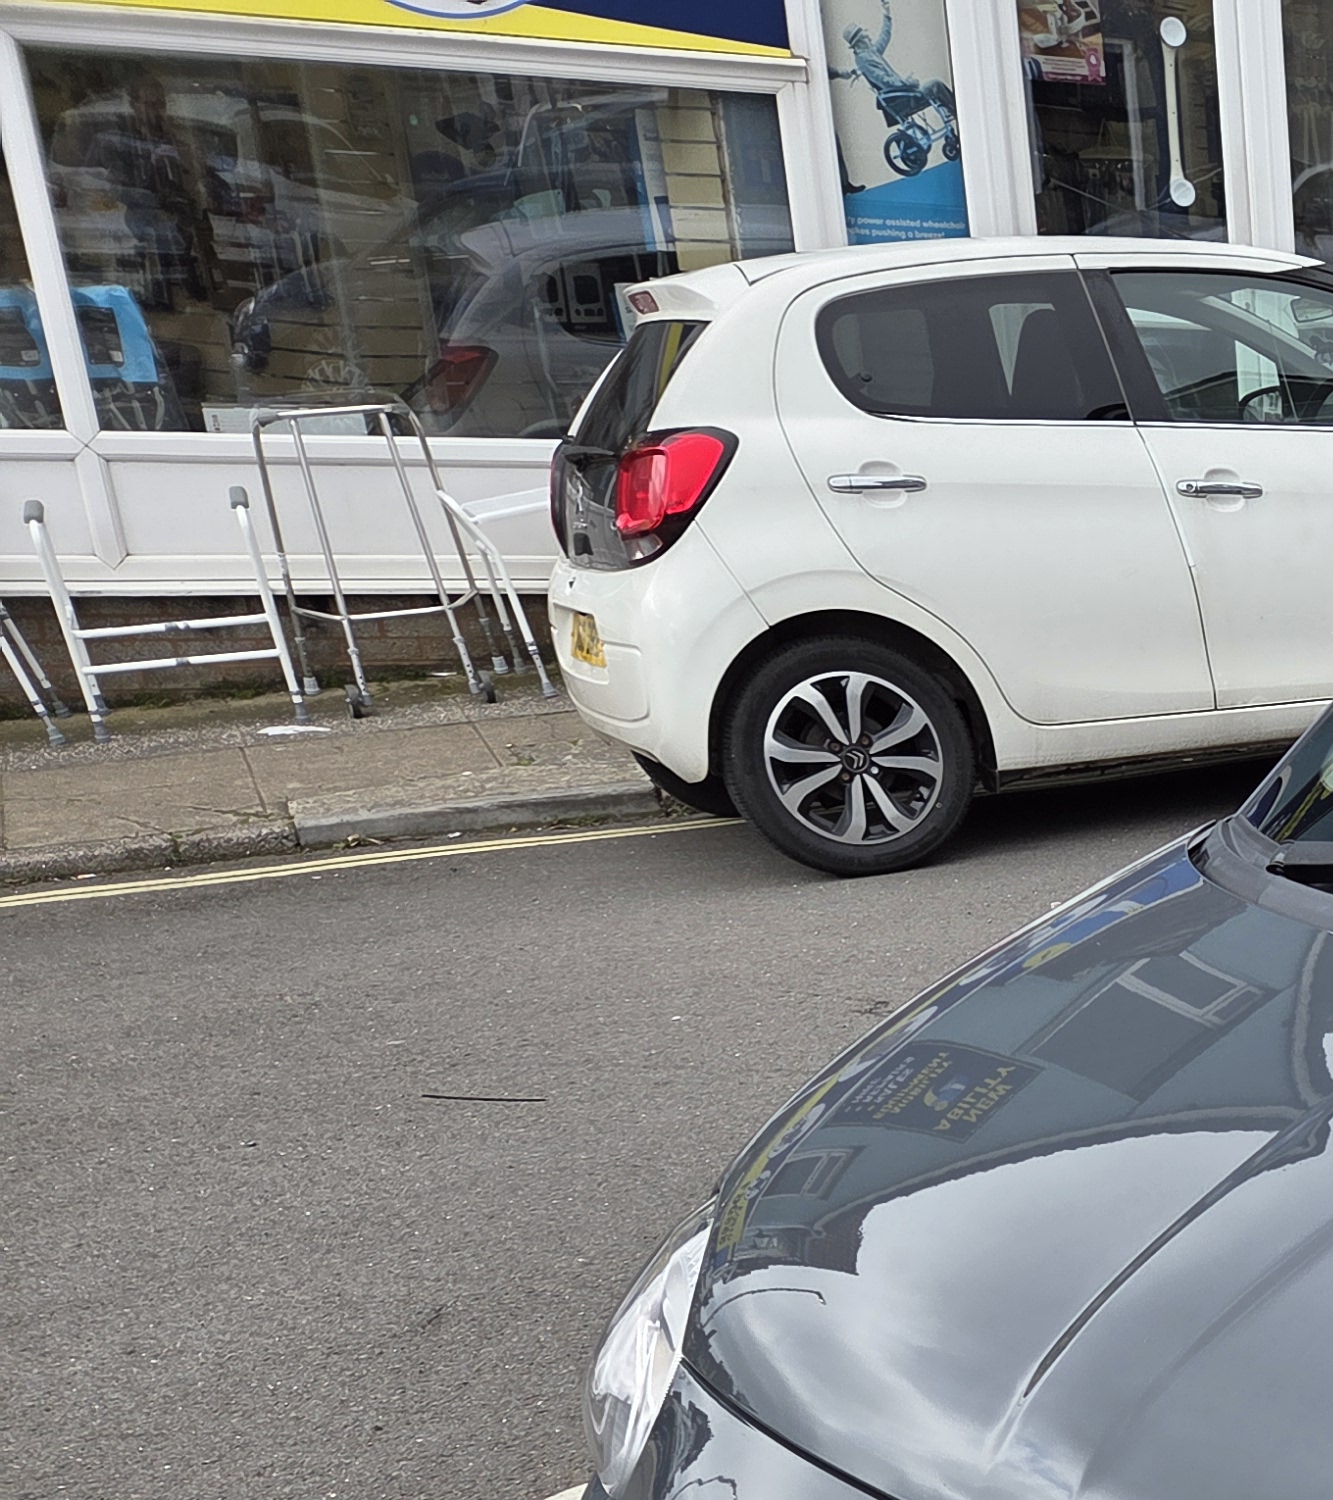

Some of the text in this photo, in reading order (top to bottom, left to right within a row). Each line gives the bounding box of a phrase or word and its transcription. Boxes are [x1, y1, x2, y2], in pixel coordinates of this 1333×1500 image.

[857, 217, 884, 226] power
[885, 219, 921, 228] assisted
[922, 220, 966, 229] wheelchair
[872, 228, 906, 239] pushing
